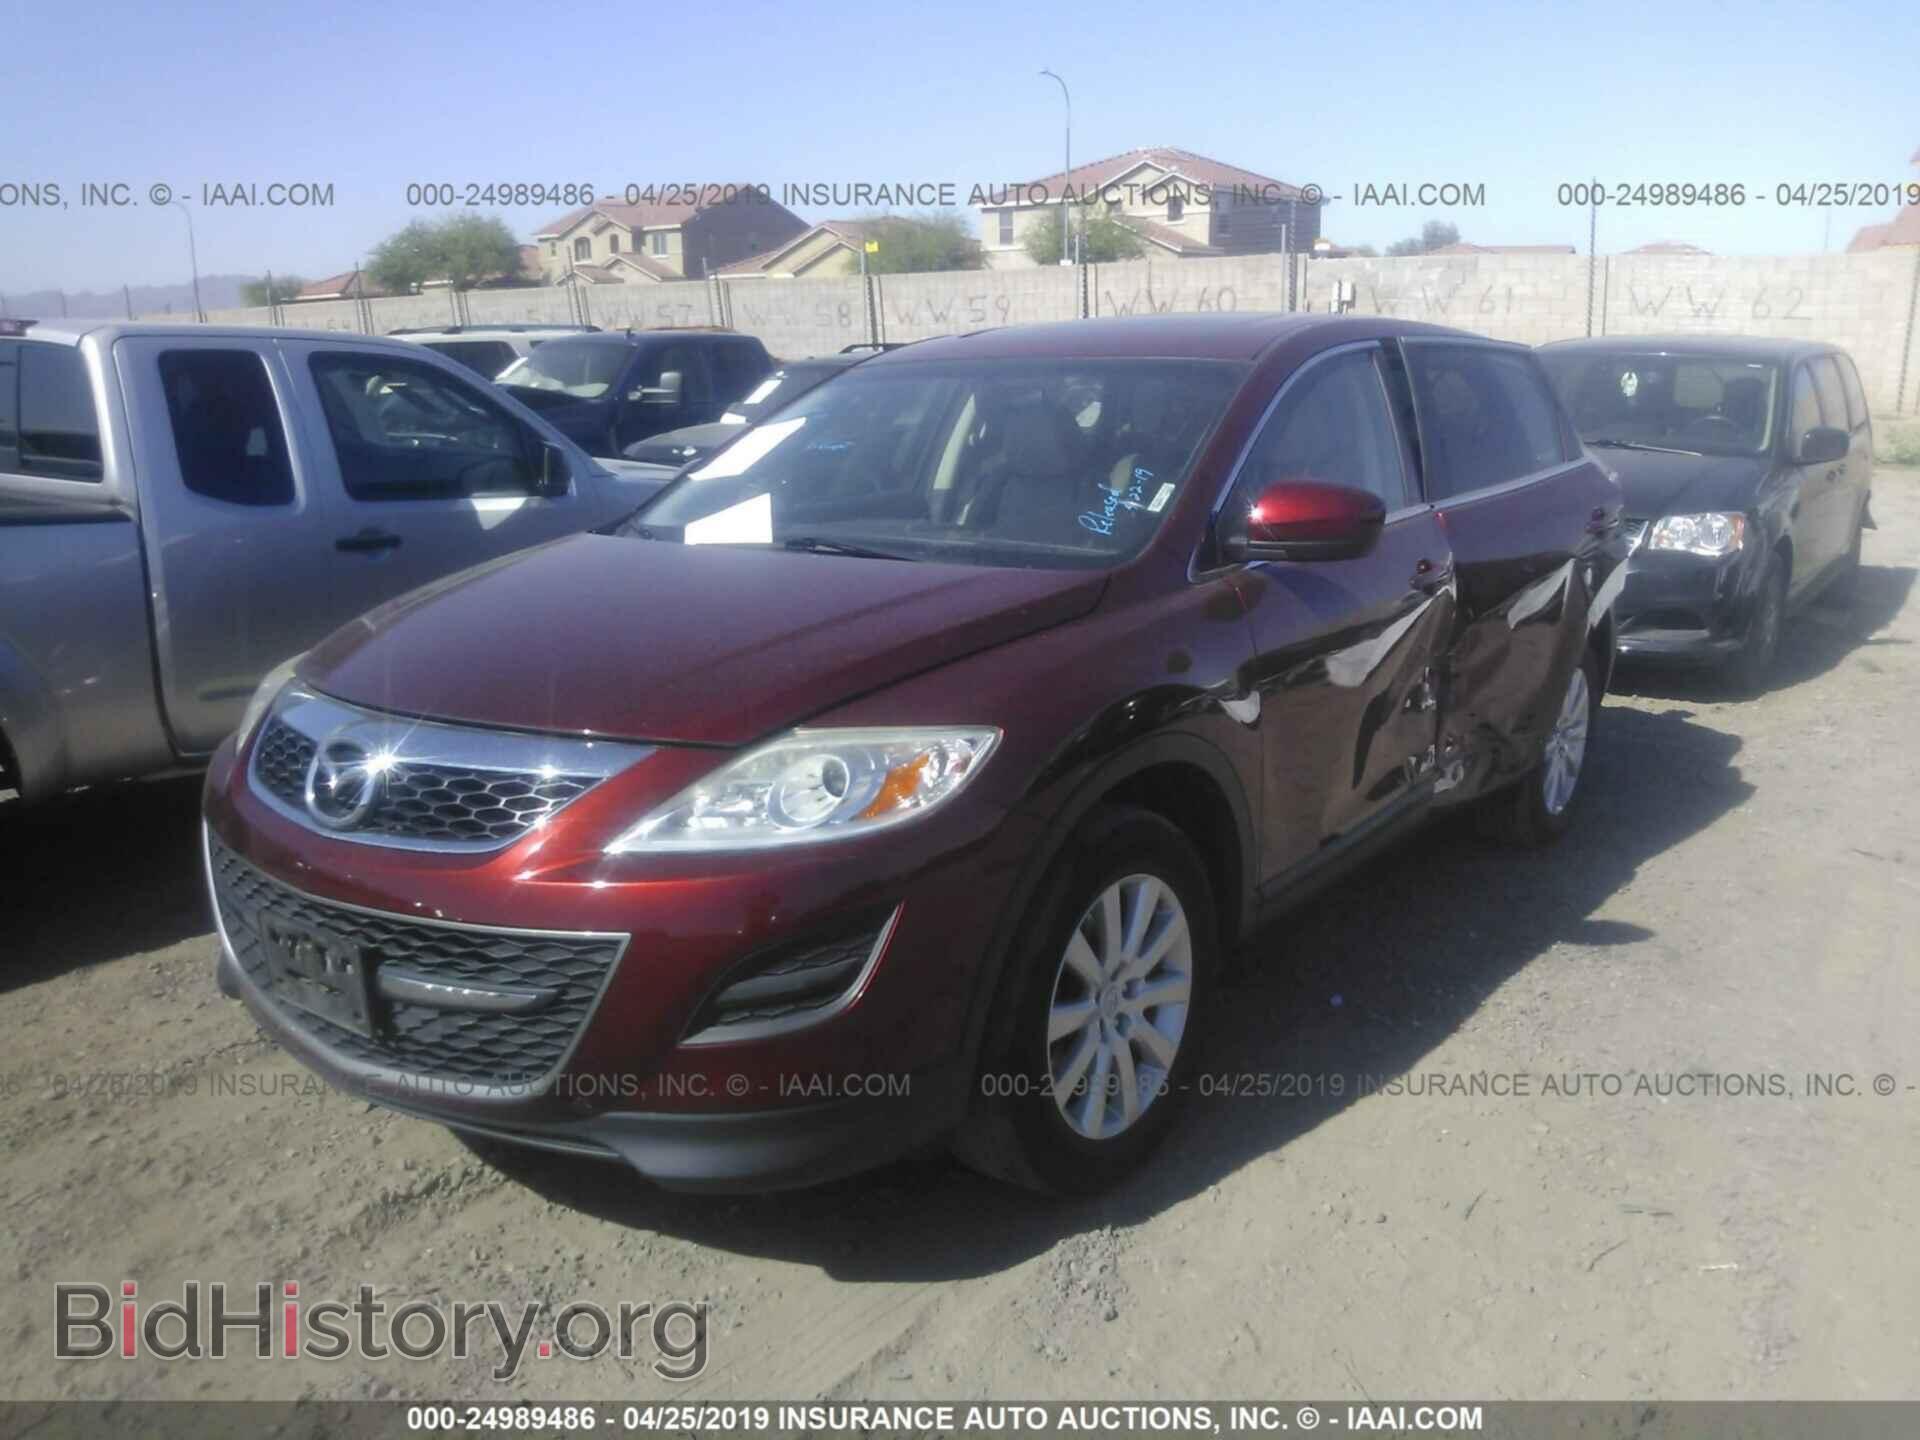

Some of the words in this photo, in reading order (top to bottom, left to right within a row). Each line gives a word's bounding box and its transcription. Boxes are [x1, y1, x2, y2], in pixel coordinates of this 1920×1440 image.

[968, 295, 1011, 324] 59
[1198, 285, 1238, 313] 60
[1478, 284, 1513, 314] 61
[1751, 287, 1812, 321] 62
